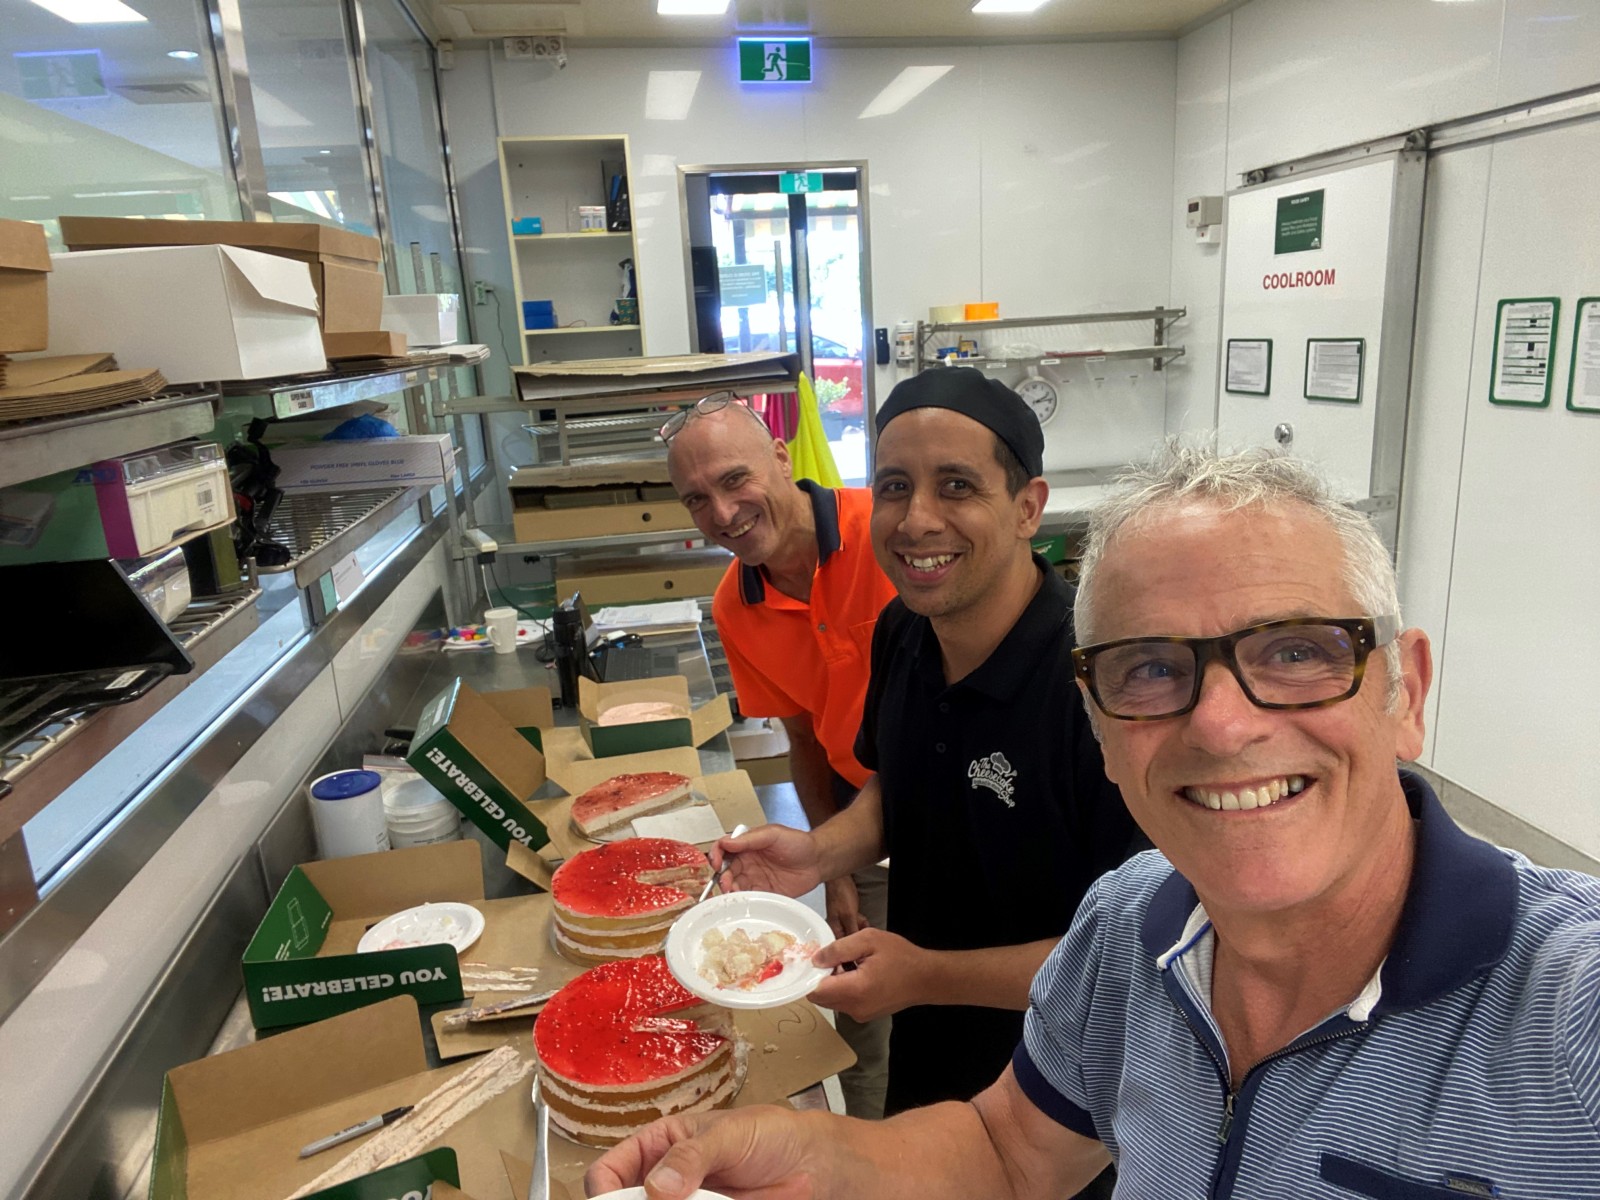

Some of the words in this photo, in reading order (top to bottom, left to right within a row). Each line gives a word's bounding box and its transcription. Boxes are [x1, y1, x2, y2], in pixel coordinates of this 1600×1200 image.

[1262, 268, 1336, 290] COOLROOM
[980, 757, 991, 769] The
[425, 747, 505, 820] CELEBRATE!
[967, 760, 1015, 794] Cheesecake
[998, 790, 1016, 808] Shop
[502, 818, 533, 847] YOU
[262, 974, 394, 1002] CELEBRATE!
[400, 967, 447, 985] YOU
